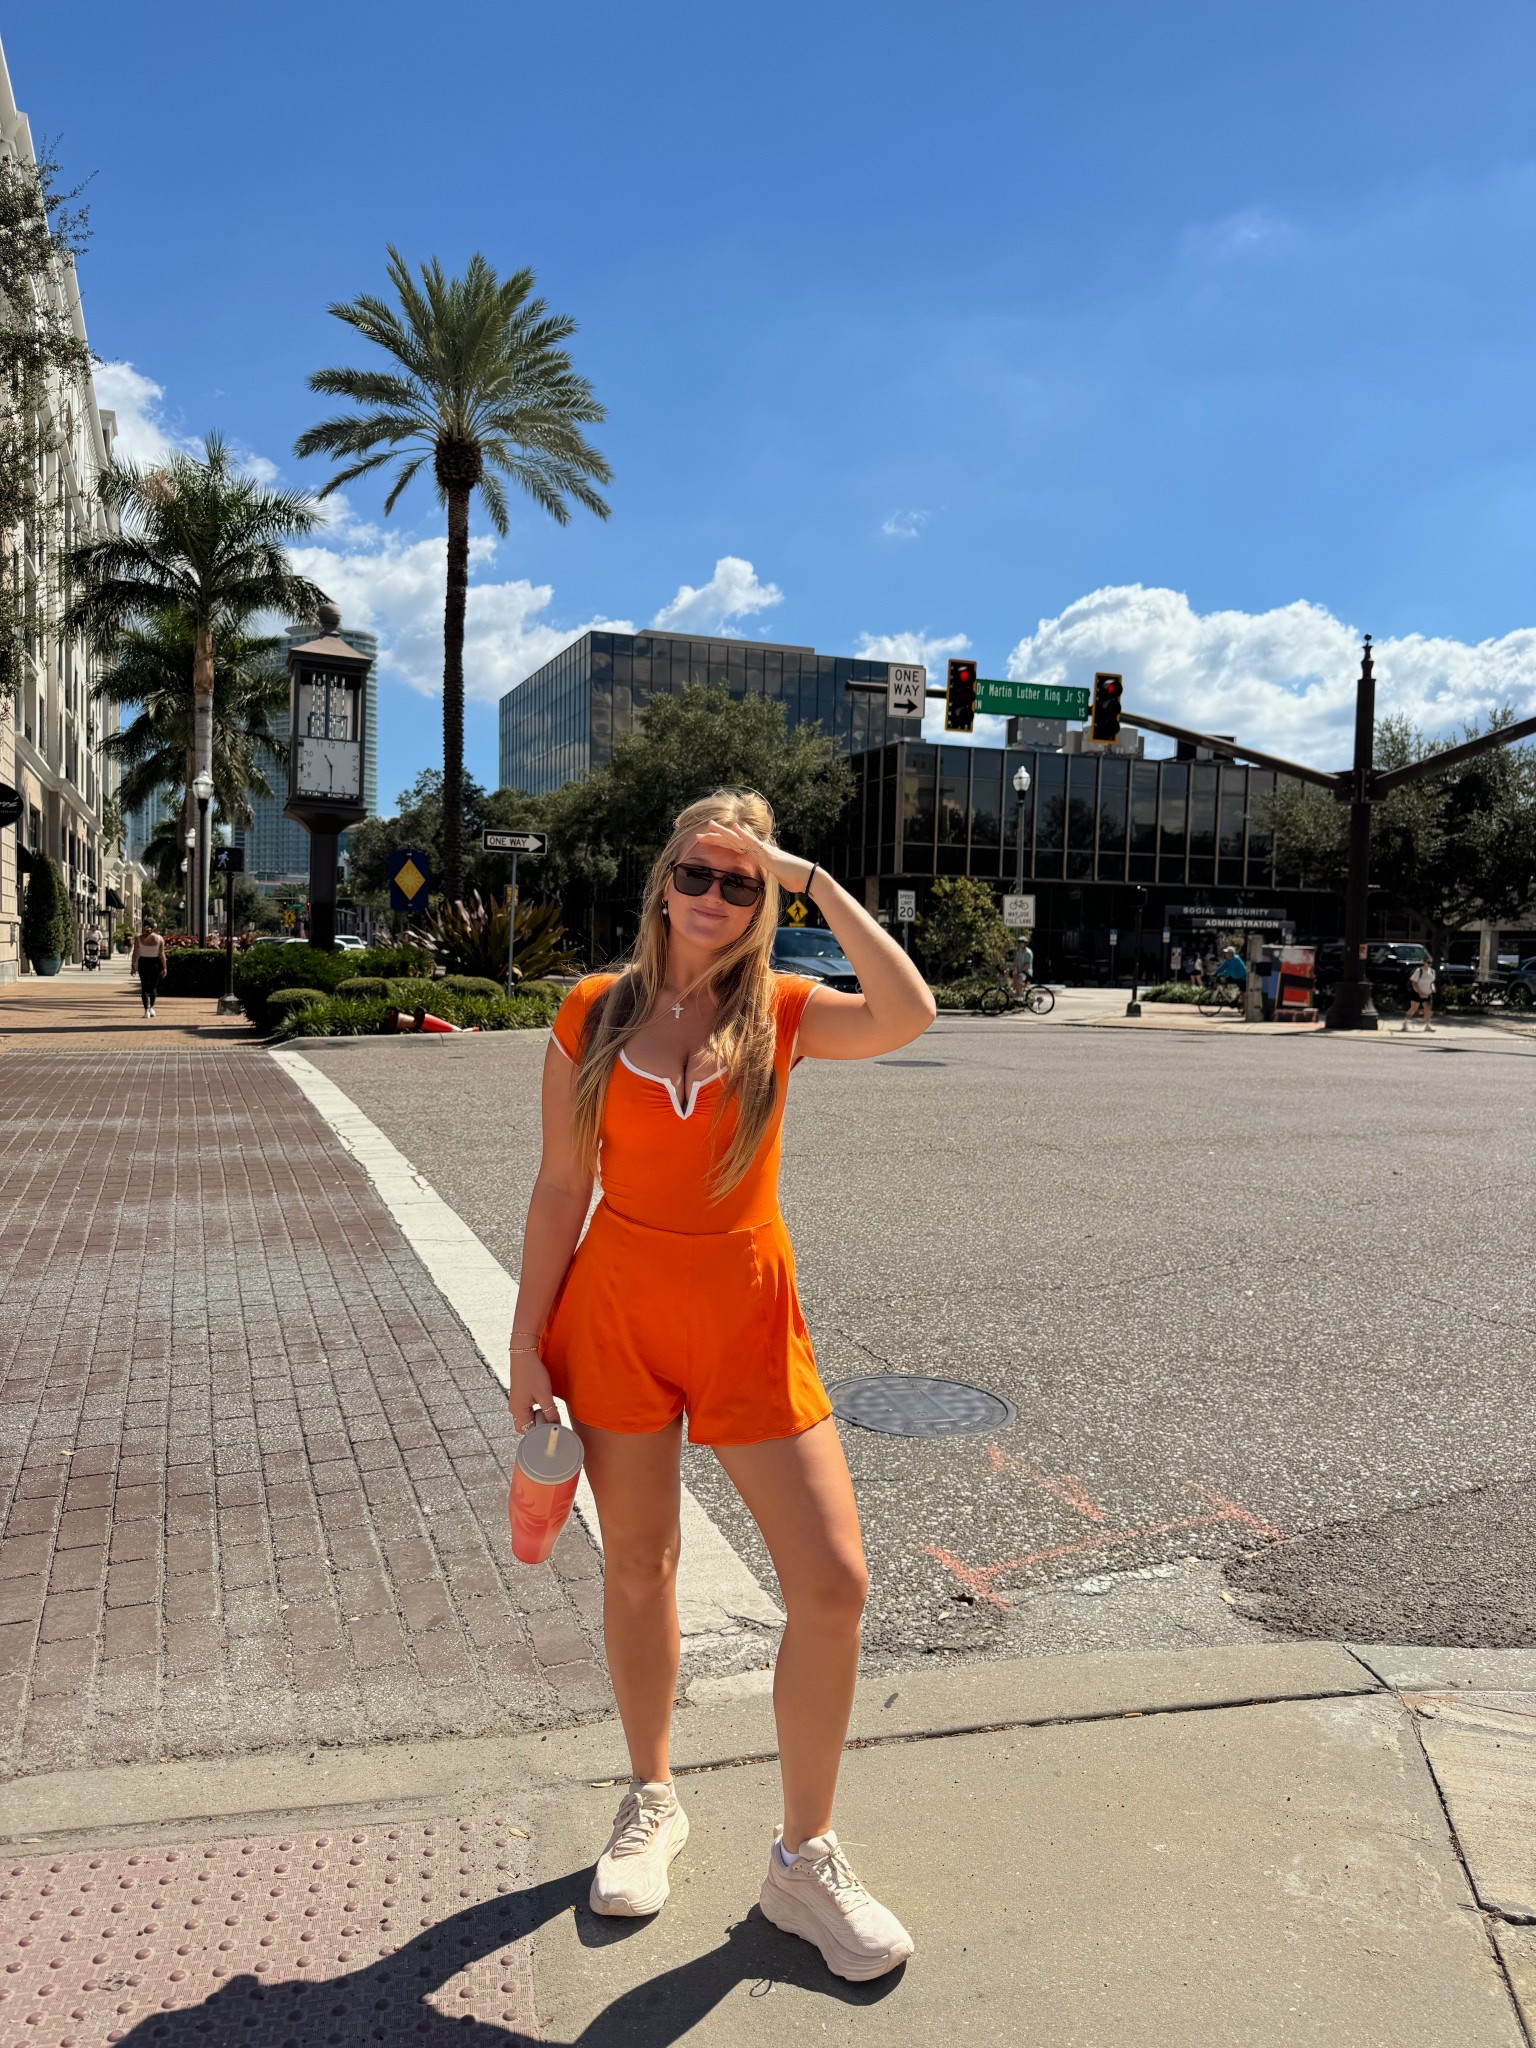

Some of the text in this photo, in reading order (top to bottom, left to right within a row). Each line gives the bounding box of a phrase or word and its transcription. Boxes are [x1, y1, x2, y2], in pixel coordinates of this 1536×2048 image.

[895, 669, 919, 682] ONE
[894, 683, 920, 696] WAY
[976, 683, 1085, 705] Dr Martin Luther King Jr St
[329, 741, 335, 749] 12
[490, 837, 526, 846] ONE WAY
[900, 906, 913, 918] 20
[1183, 906, 1269, 916] SOCIAL SECURITY
[1205, 918, 1279, 928] ADMINISTRATION
